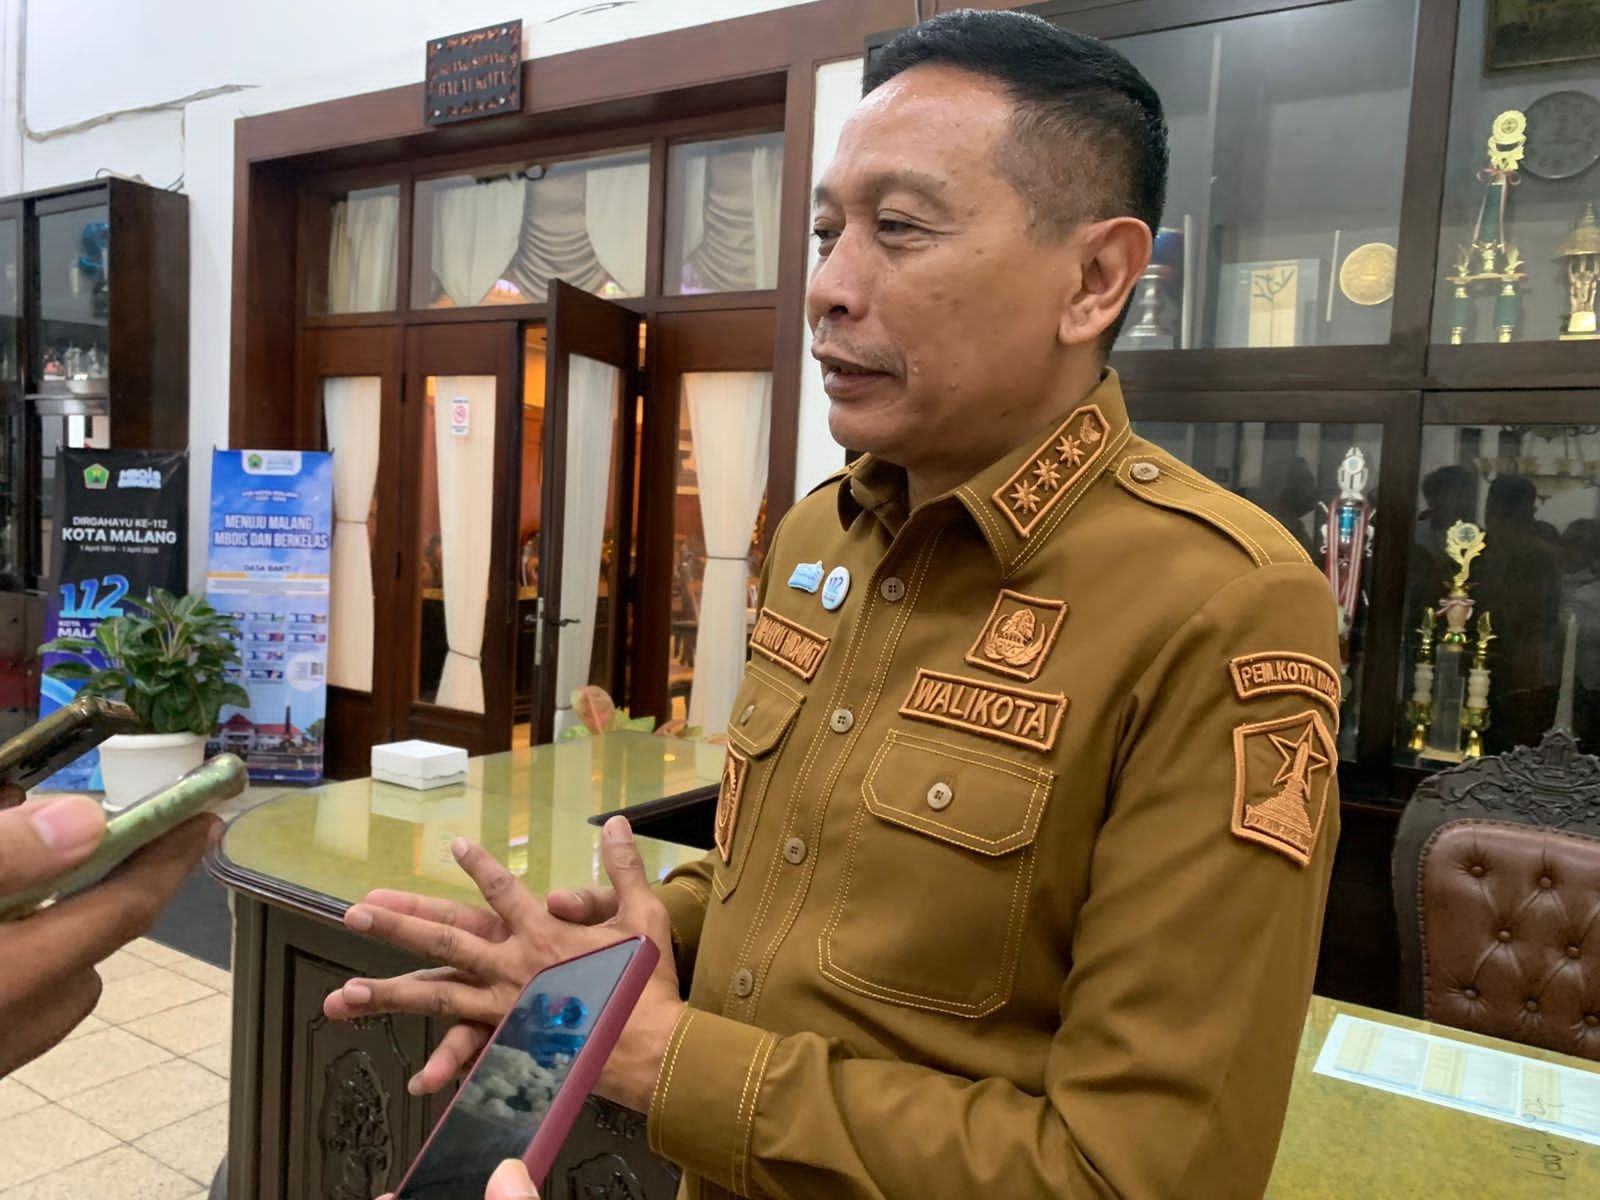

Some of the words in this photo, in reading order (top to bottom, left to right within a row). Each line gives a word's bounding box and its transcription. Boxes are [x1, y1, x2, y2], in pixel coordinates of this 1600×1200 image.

[72, 516, 133, 528] DIRGAHAYU
[135, 518, 168, 529] KE-112
[225, 514, 267, 529] MENUJU
[268, 515, 313, 531] MALANG
[62, 528, 107, 542] KOTA
[110, 529, 177, 544] MALANG
[214, 531, 249, 547] MBOIS
[250, 532, 273, 547] DAN
[273, 532, 328, 549] BERKELAS
[59, 574, 129, 619] 112
[57, 628, 97, 639] MALA
[914, 678, 1047, 738] WALIKOTA
